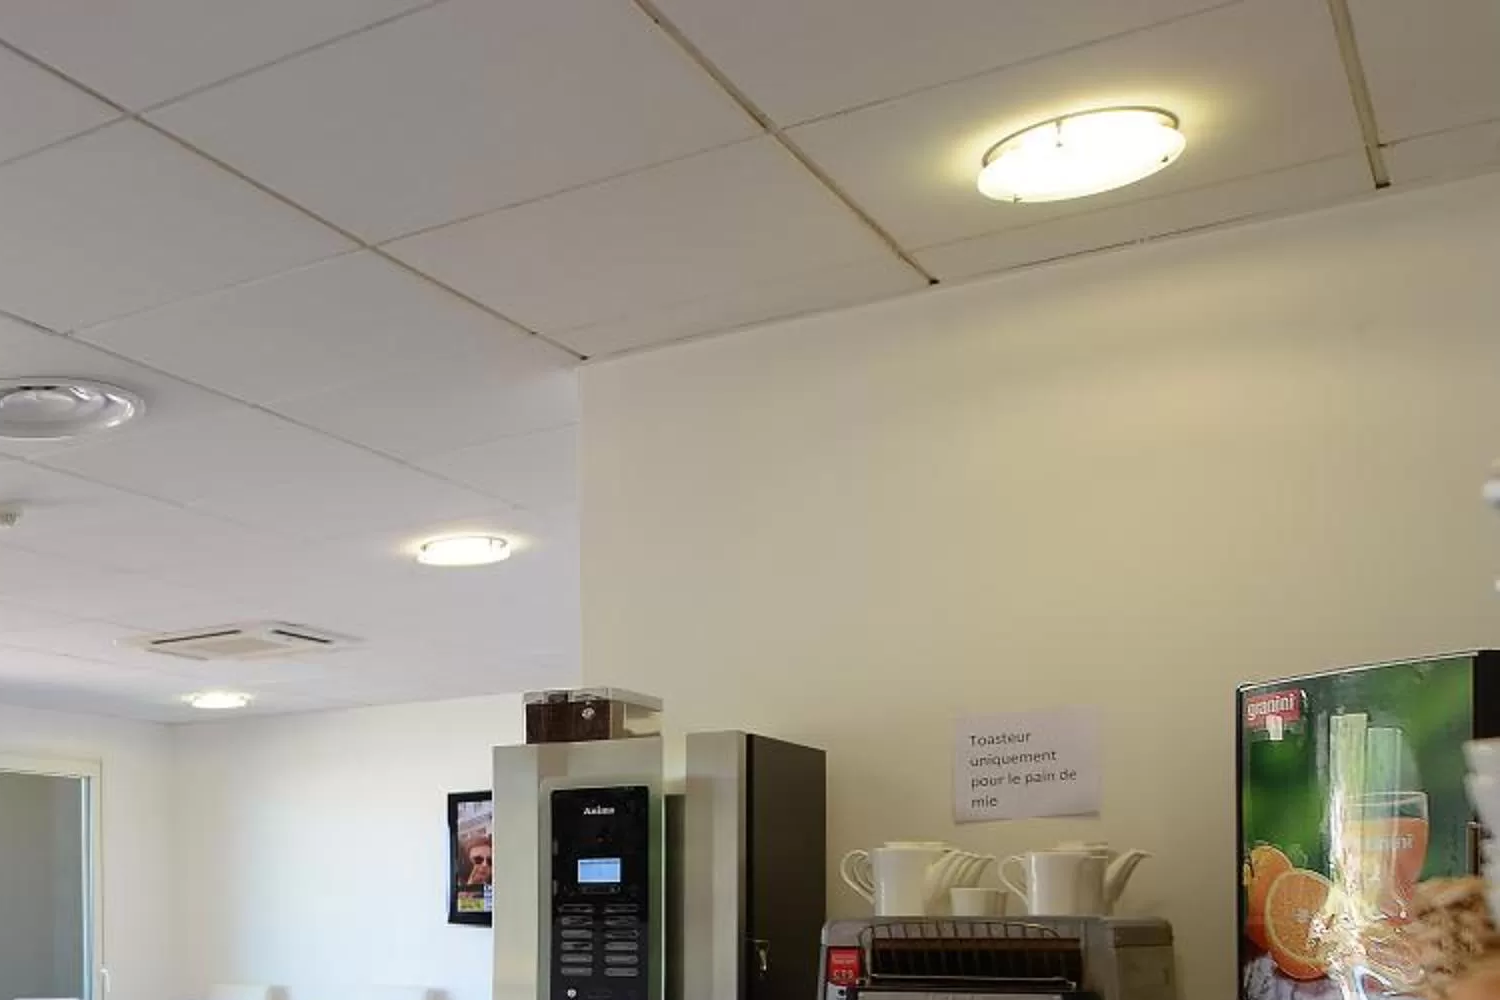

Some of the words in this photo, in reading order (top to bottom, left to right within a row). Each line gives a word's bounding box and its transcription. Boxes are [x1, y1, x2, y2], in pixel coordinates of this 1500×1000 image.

[1247, 693, 1294, 721] granini
[968, 732, 1031, 746] Toasteur
[970, 751, 1057, 767] uniquement
[971, 776, 1004, 790] pour
[1007, 772, 1020, 785] le
[1025, 772, 1055, 786] pain
[1059, 769, 1077, 781] de
[971, 795, 997, 808] mie
